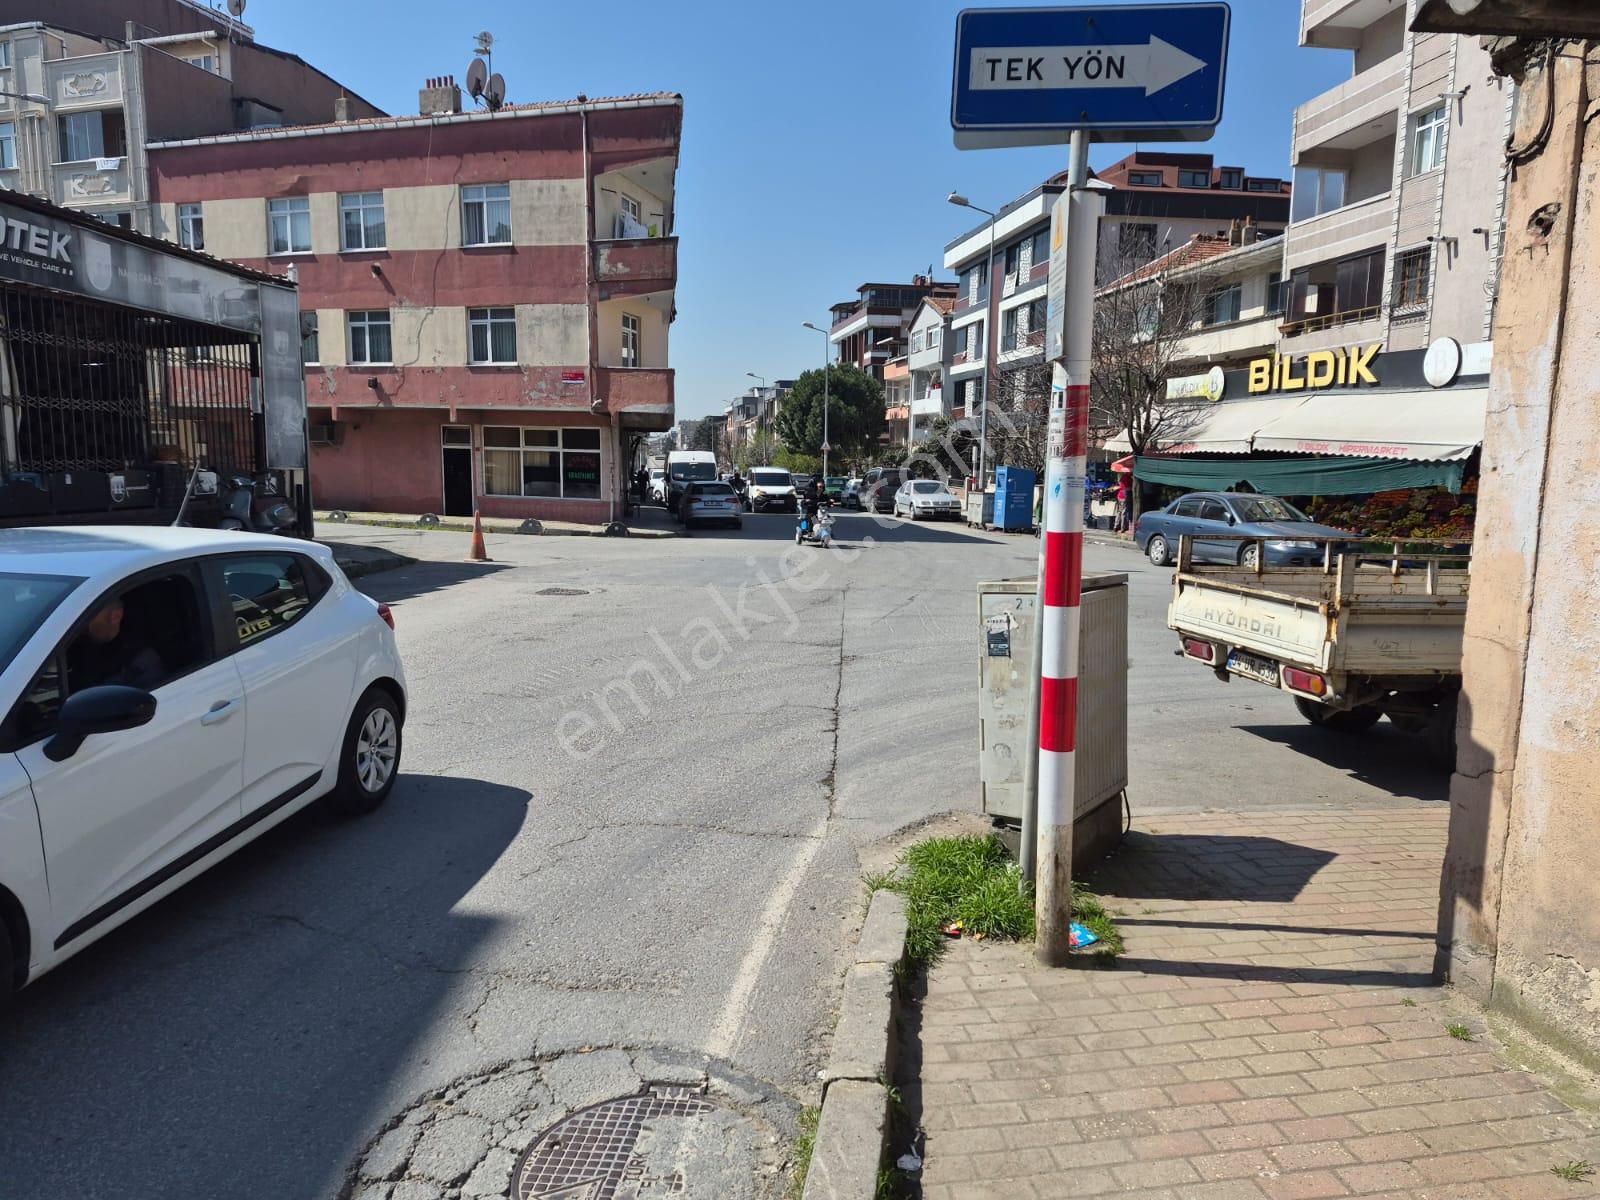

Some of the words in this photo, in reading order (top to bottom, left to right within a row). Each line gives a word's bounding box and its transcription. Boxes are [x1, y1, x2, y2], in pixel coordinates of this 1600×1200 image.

[985, 57, 1045, 81] TEK
[1063, 49, 1125, 80] YÖN
[11, 255, 40, 268] VEHICLE
[41, 262, 61, 273] CARE
[1248, 343, 1384, 393] BİLDİK
